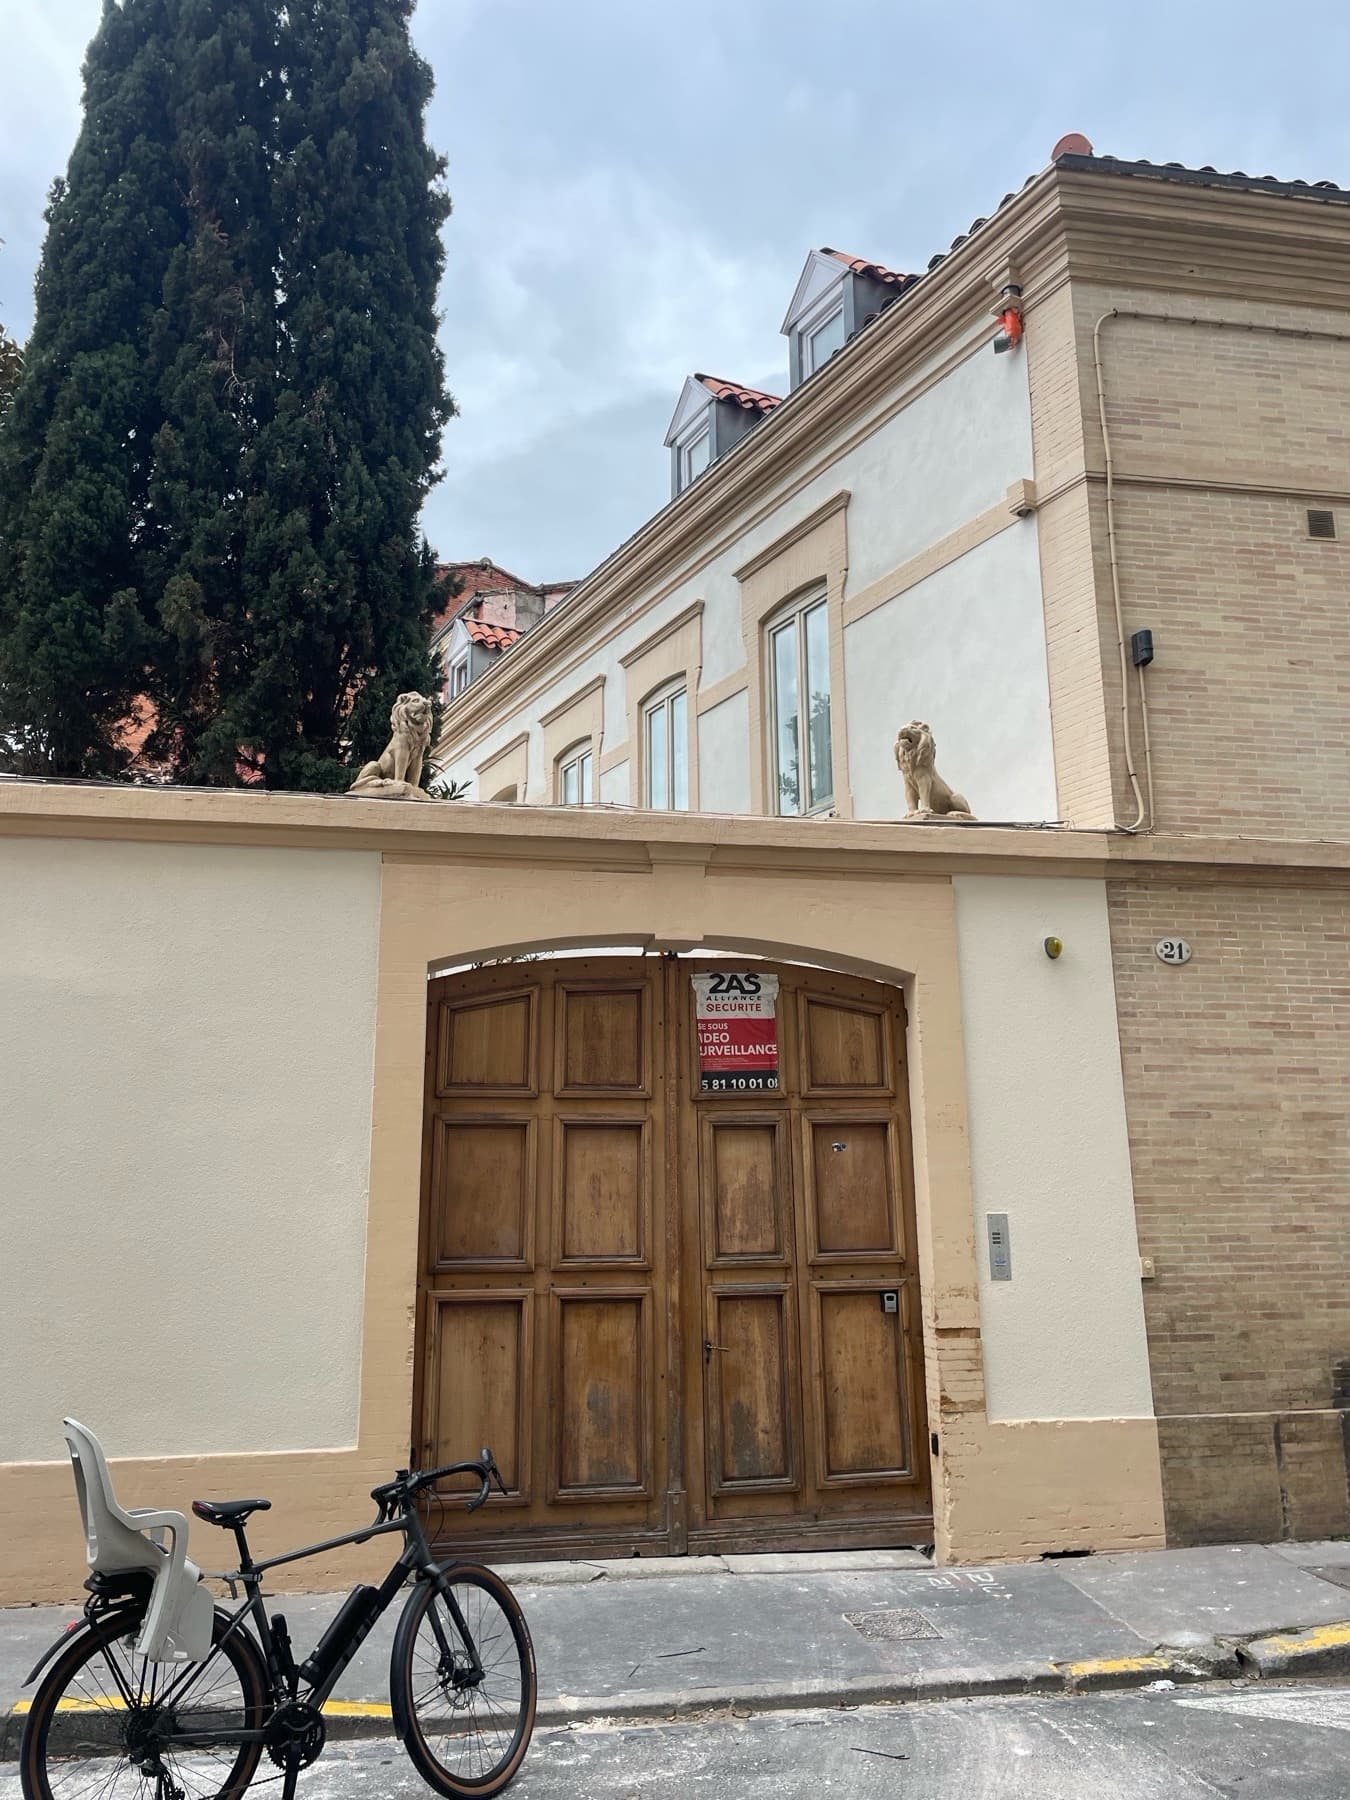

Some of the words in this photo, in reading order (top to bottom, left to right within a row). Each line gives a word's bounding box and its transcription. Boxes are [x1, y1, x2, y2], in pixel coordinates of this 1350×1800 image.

[1163, 941, 1184, 960] 21
[709, 973, 761, 994] 2AS
[706, 1003, 762, 1012] SECURITE
[731, 1079, 746, 1089] 10
[749, 1078, 763, 1088] 01
